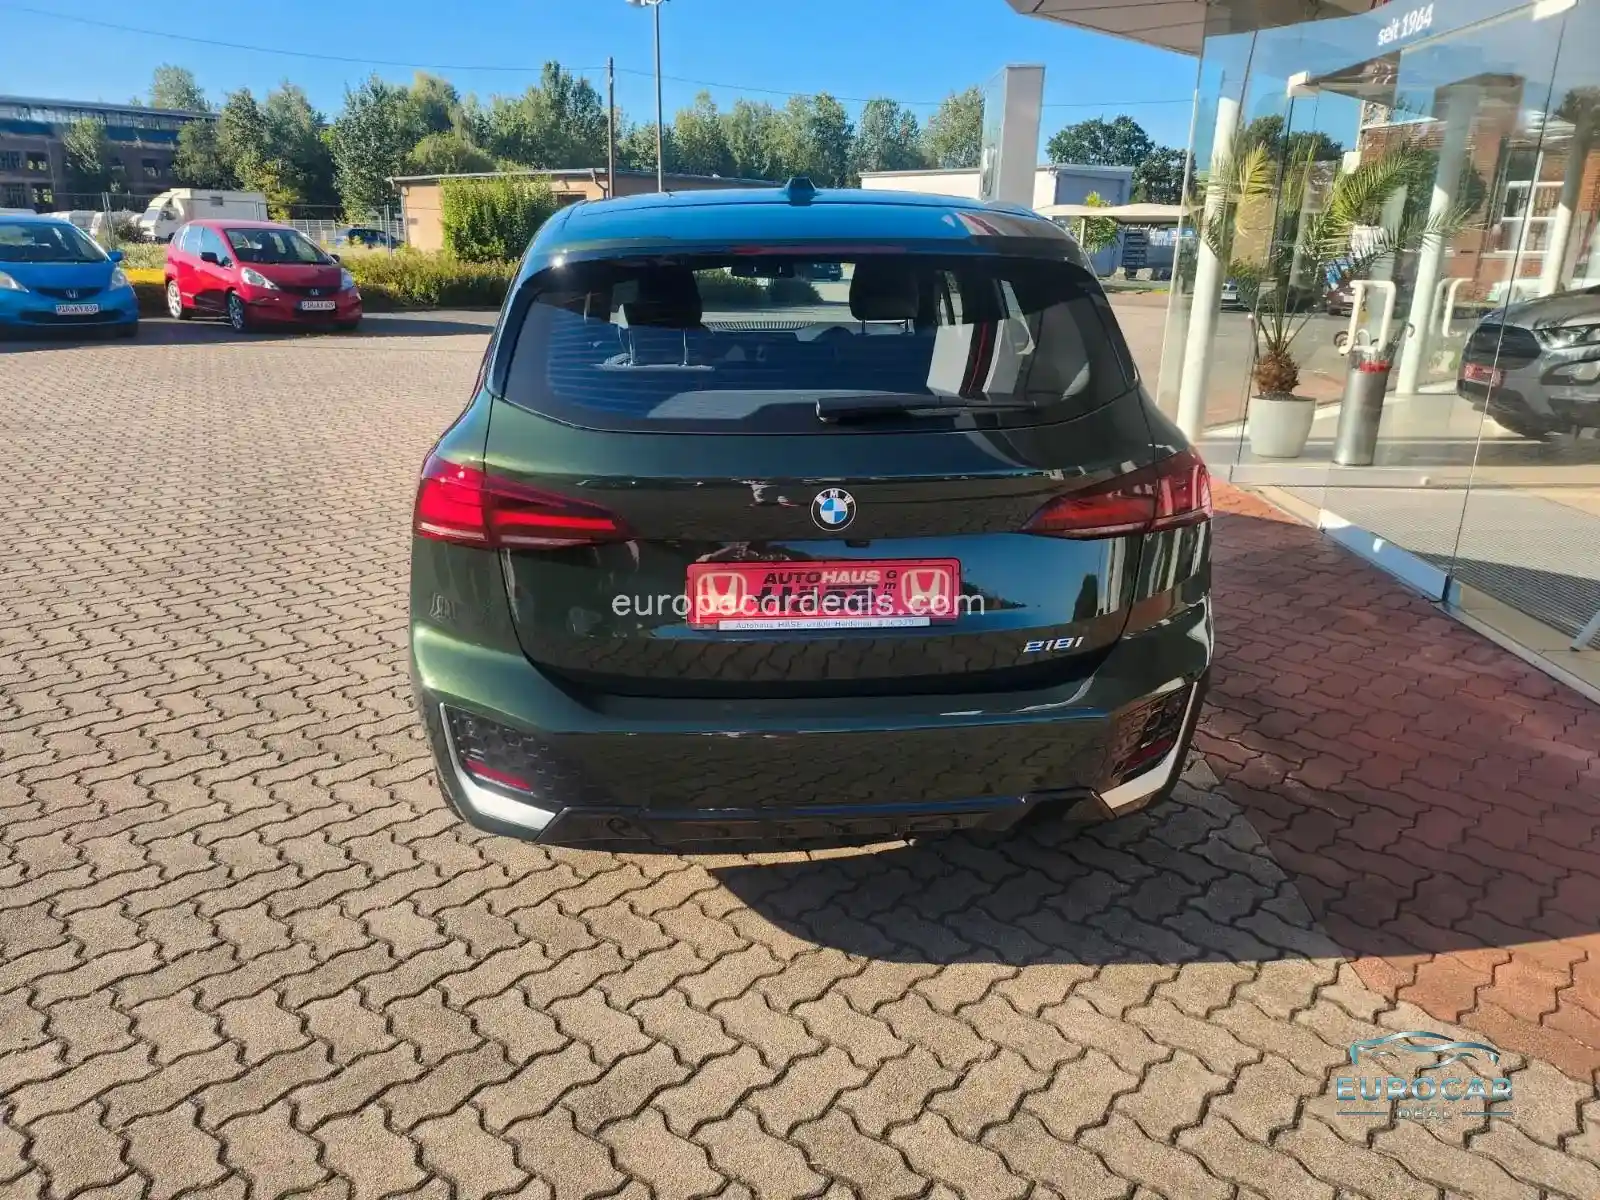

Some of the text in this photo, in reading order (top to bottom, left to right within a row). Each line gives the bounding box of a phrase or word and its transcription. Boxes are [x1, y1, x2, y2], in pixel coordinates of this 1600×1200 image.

[1377, 3, 1434, 46] seit 1964
[815, 489, 854, 505] BMW
[763, 569, 880, 585] AUTOHAUS
[1022, 636, 1084, 653] 218i
